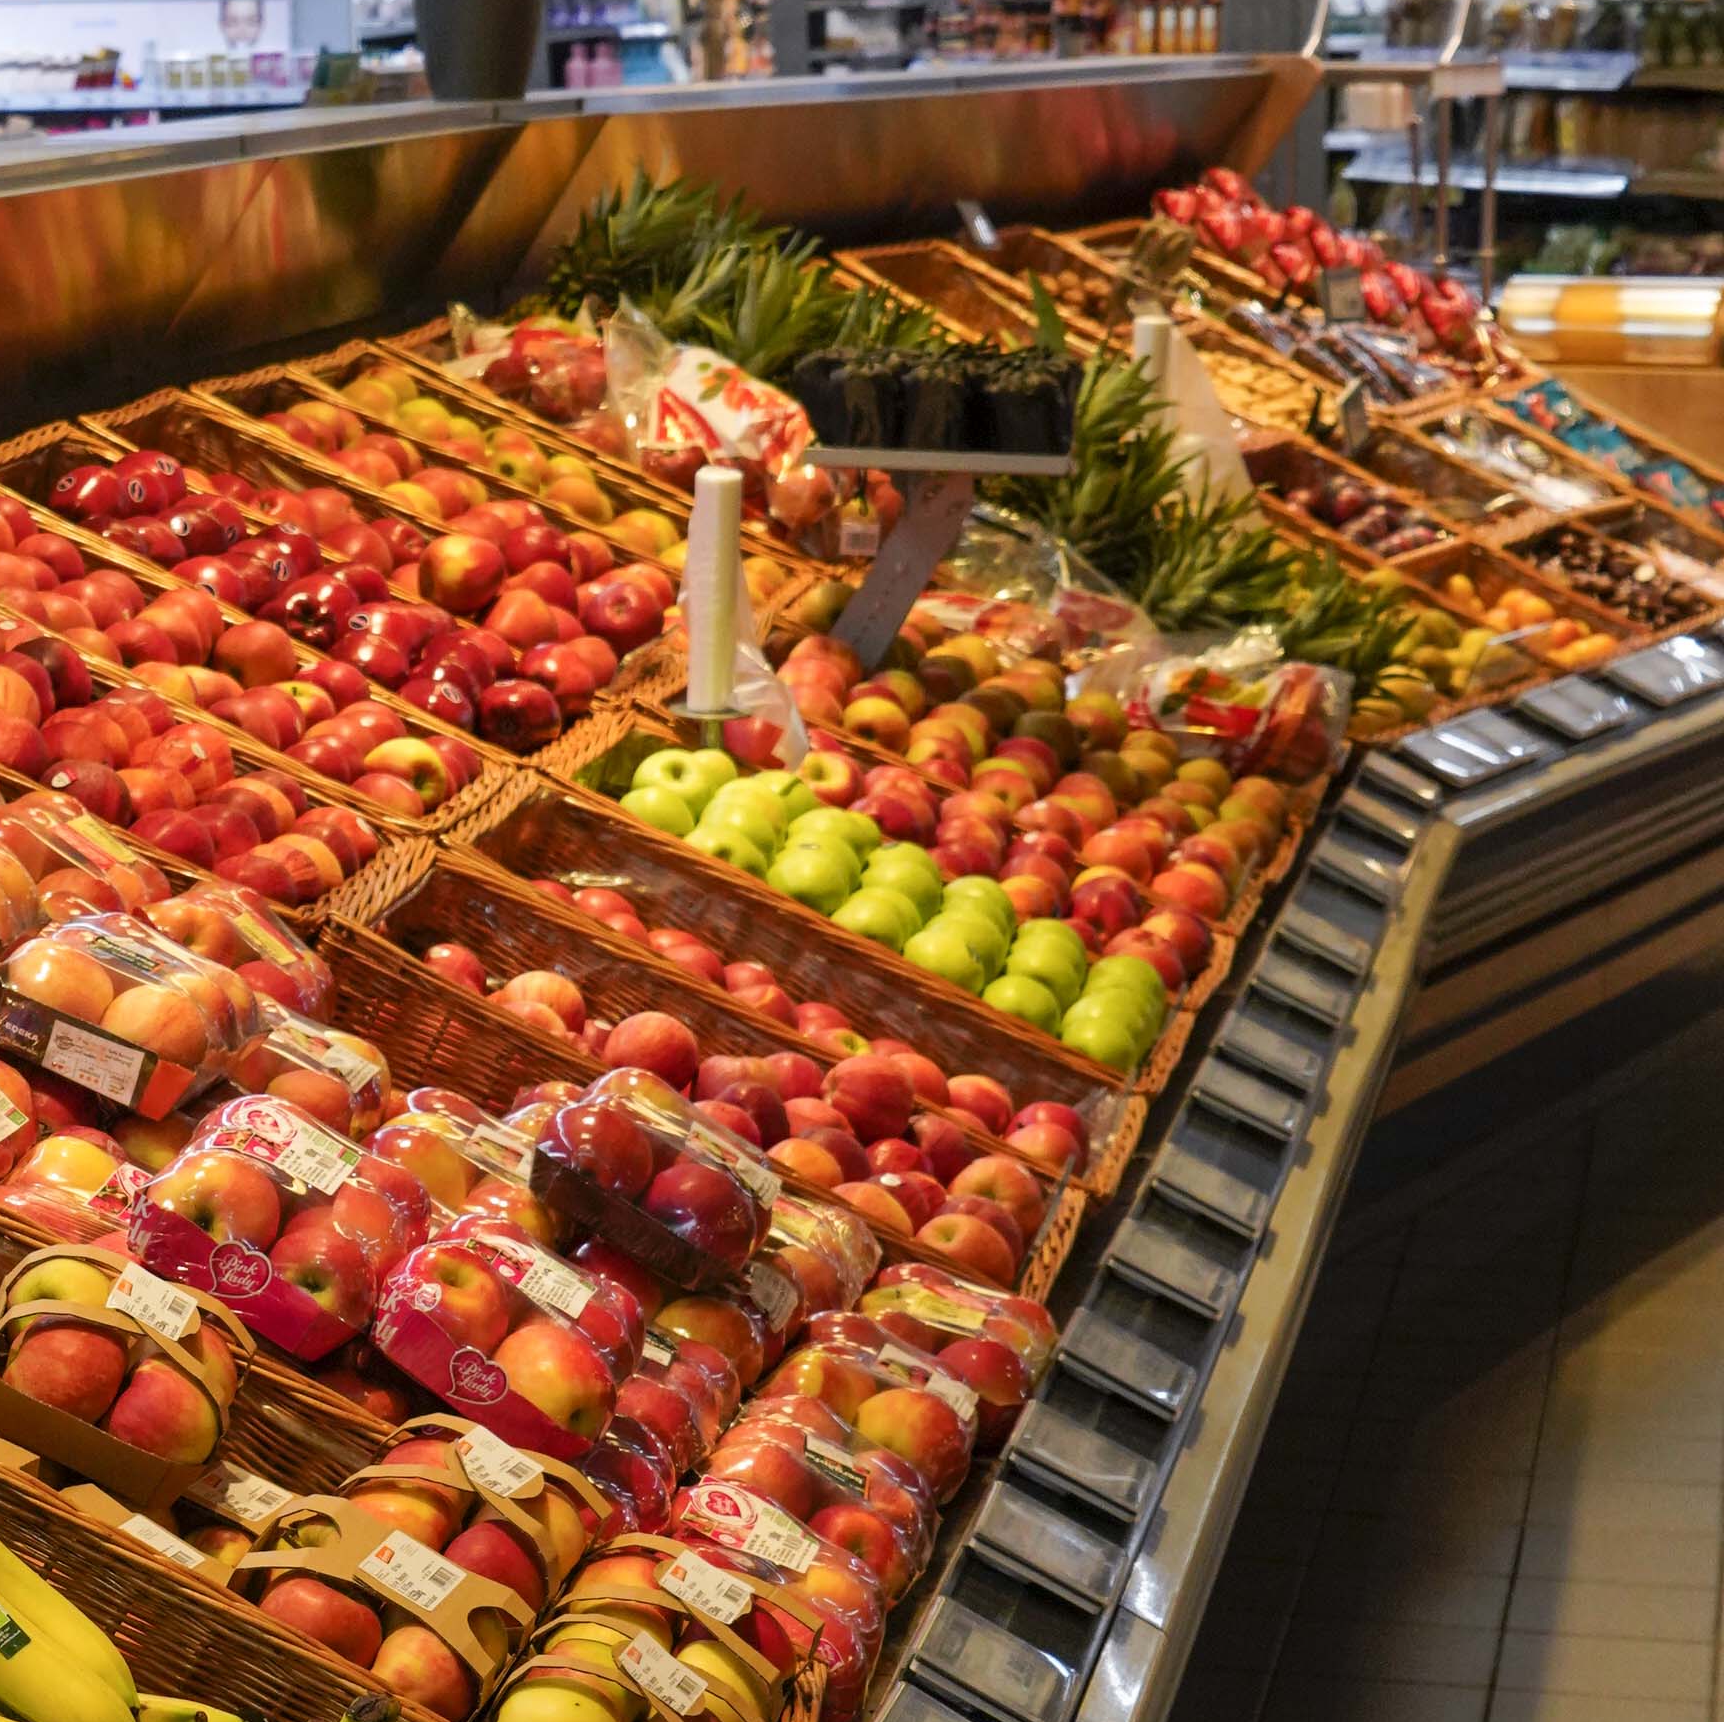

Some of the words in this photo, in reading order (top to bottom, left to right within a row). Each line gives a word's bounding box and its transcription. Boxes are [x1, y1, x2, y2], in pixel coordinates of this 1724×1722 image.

[219, 1254, 258, 1276] Pink
[222, 1270, 258, 1290] Lady
[459, 1361, 497, 1384] Pink
[458, 1377, 496, 1398] Lady
